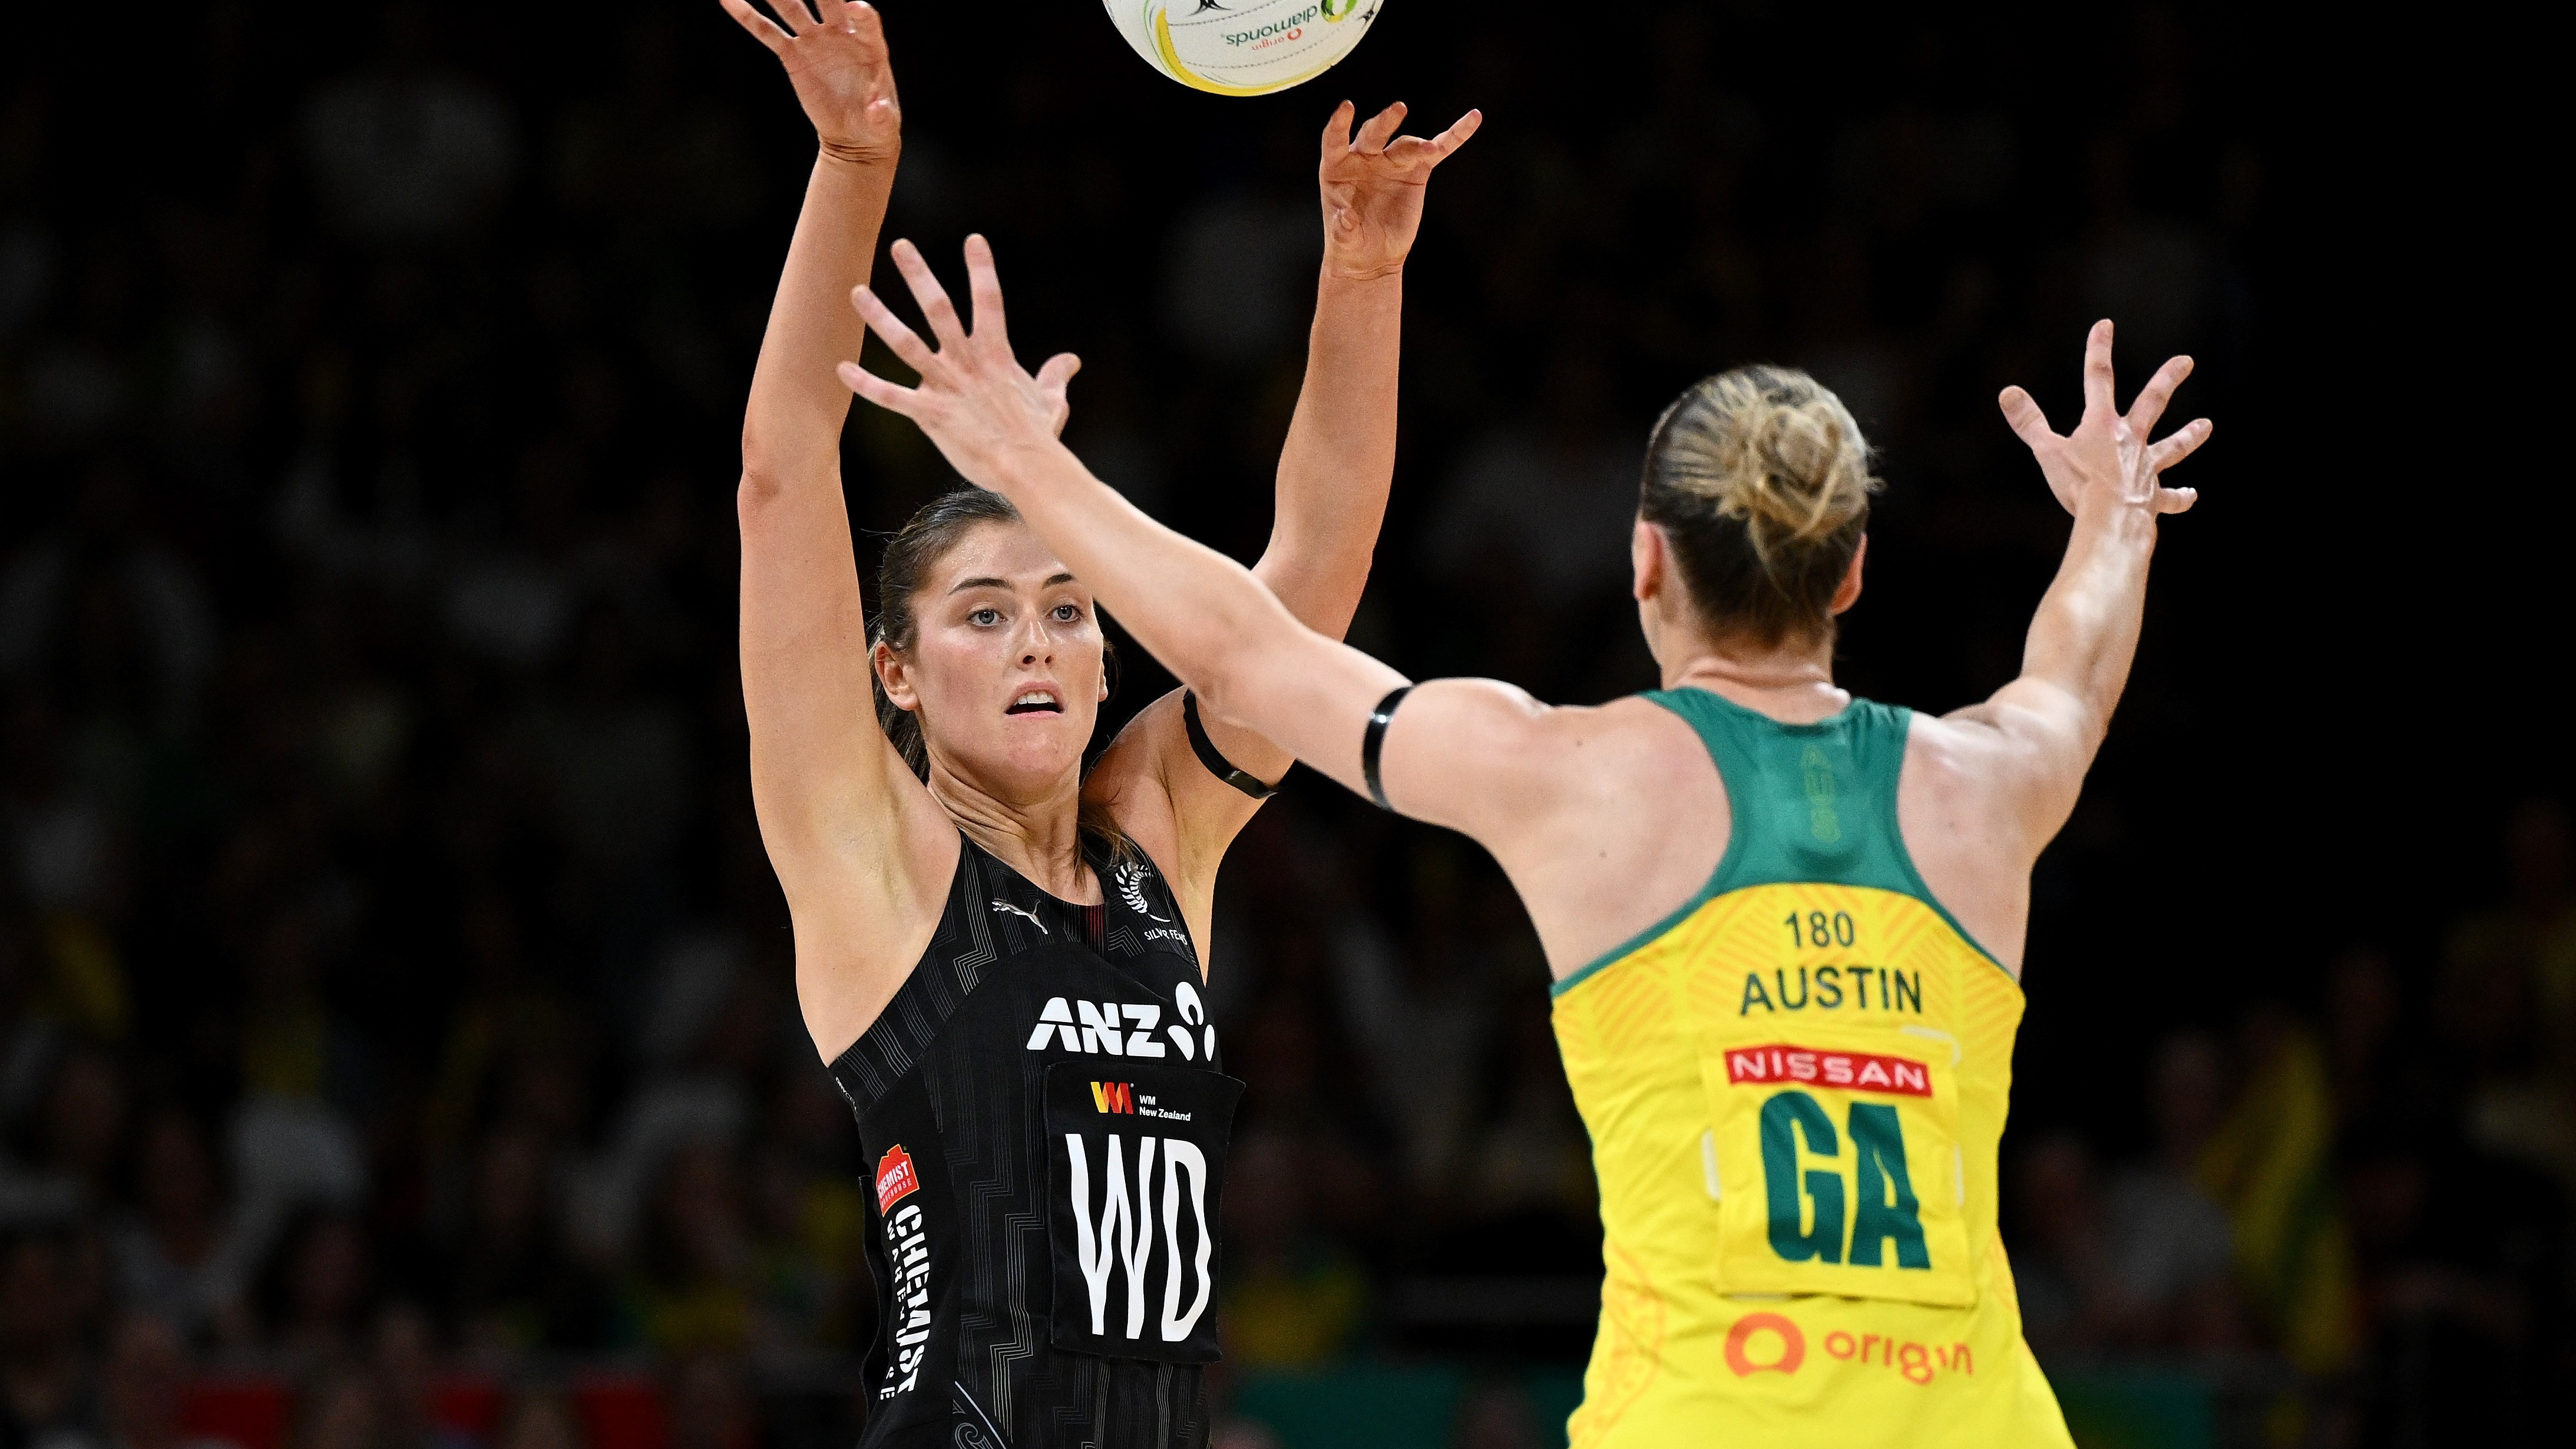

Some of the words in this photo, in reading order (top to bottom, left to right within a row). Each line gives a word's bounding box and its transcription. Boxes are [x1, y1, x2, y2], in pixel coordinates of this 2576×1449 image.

[1226, 5, 1318, 47] diamonds
[1785, 912, 1854, 947] 180
[1740, 966, 1922, 1015] AUSTIN
[1026, 997, 1166, 1058] ANZ
[1731, 1050, 1927, 1090] NISSAN
[1139, 1094, 1156, 1106] WM
[1139, 1106, 1157, 1117] New
[1158, 1108, 1191, 1122] Zealand
[1759, 1090, 1932, 1271] GA
[1064, 1133, 1212, 1342] WD
[895, 1205, 931, 1394] CHEMIST
[1825, 1331, 1973, 1385] origin
